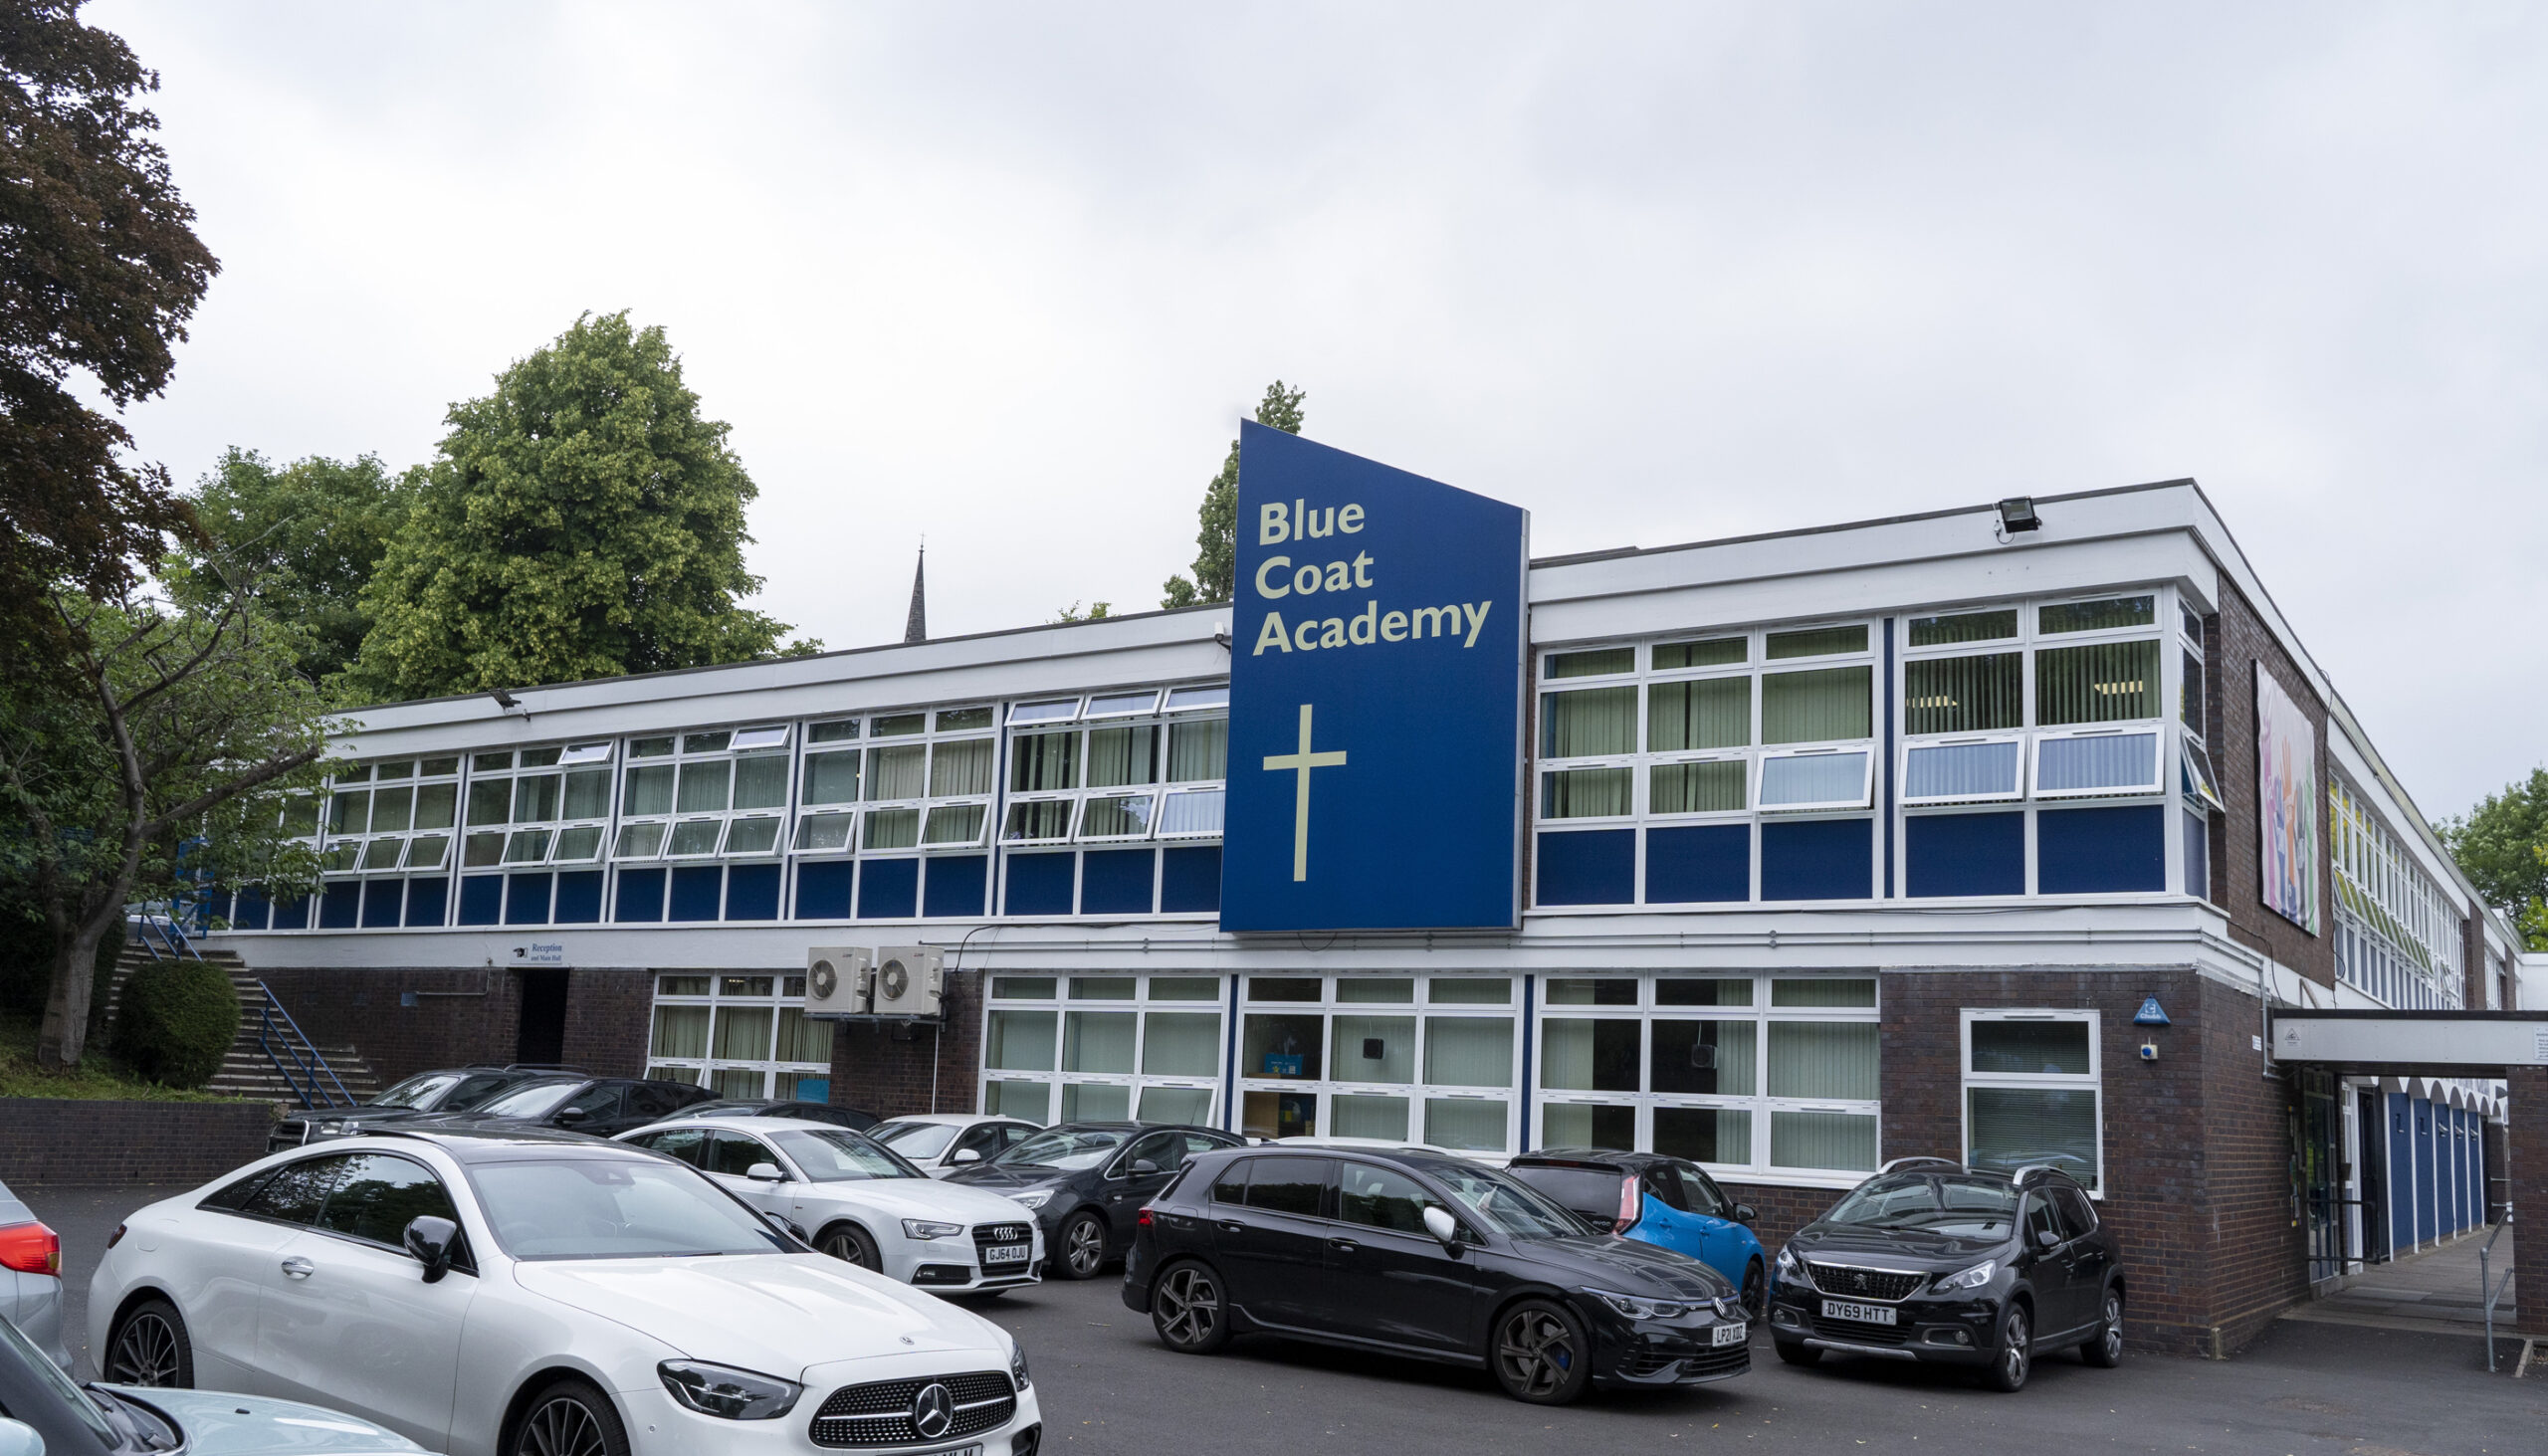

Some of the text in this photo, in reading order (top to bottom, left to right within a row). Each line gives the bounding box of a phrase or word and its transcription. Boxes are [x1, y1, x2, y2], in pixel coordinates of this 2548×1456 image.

[1259, 499, 1365, 545] Blue
[1255, 549, 1375, 599] Coat
[1252, 600, 1493, 657] Academy
[531, 943, 562, 953] Reception
[989, 1248, 1010, 1261] GJ64
[1827, 1303, 1889, 1322] DY69 HTT
[1716, 1327, 1732, 1344] LP21
